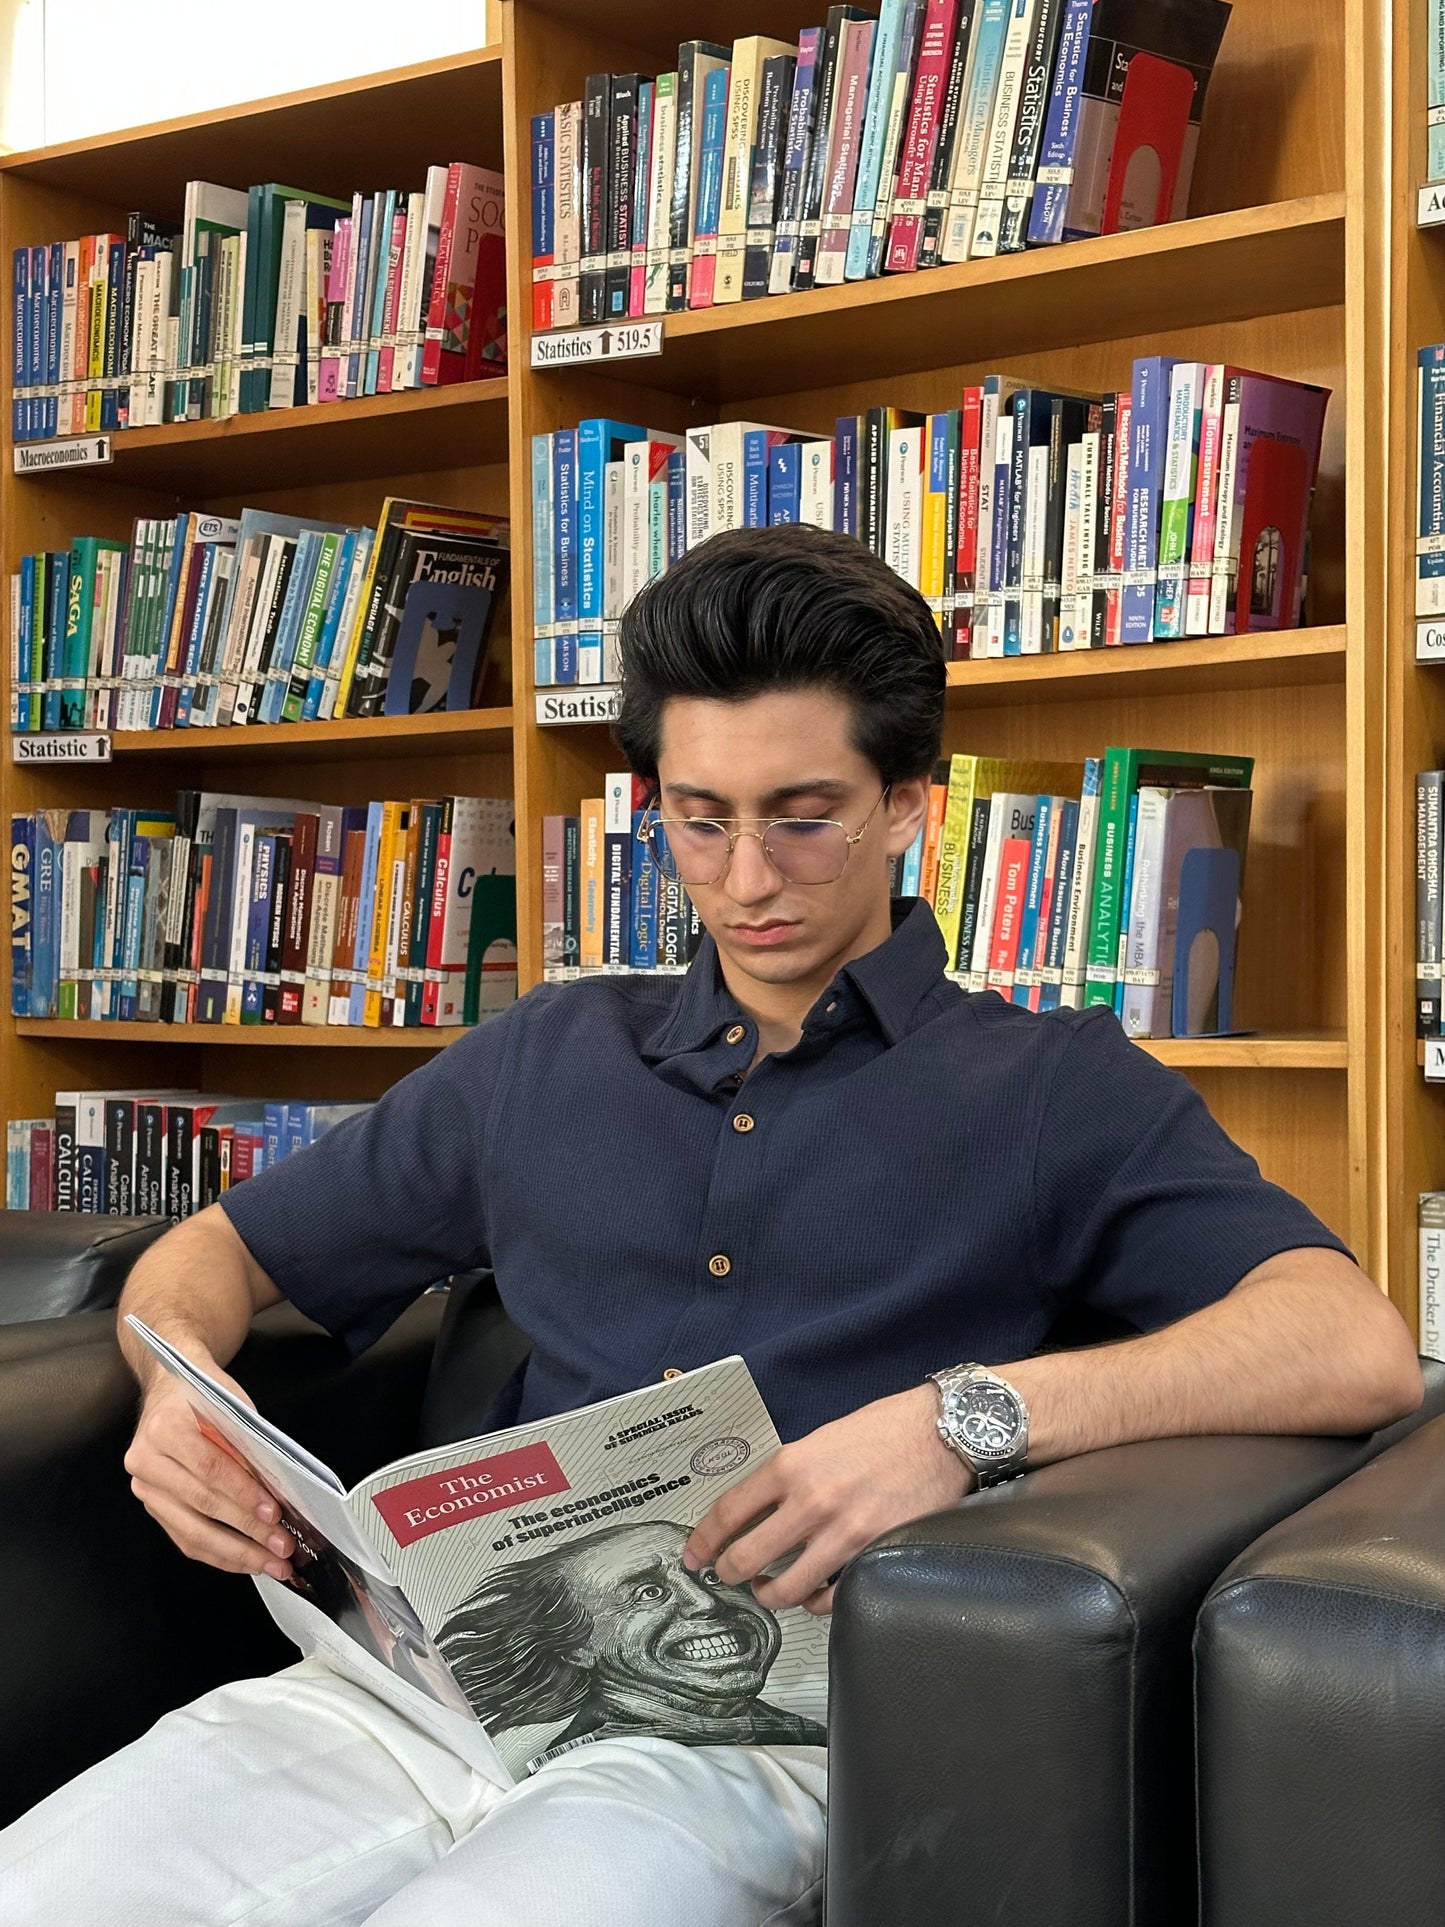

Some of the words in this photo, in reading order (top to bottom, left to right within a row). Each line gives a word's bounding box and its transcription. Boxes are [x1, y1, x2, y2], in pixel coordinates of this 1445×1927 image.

[1071, 12, 1088, 66] Statistics
[980, 46, 996, 98] Statistics
[1055, 32, 1073, 96] Economics
[1069, 69, 1078, 82] for
[733, 80, 741, 113] USING
[793, 90, 801, 112] and
[914, 75, 927, 105] Using
[921, 74, 938, 134] Statistics
[978, 101, 988, 117] for
[997, 72, 1015, 128] BUSINESS
[1018, 66, 1045, 146] Statistics
[1060, 86, 1078, 137] Business
[560, 104, 572, 144] ASIC
[621, 114, 630, 146] Applied
[731, 116, 739, 140] SPSS
[786, 114, 799, 165] Statistics
[794, 88, 809, 151] Probability
[916, 138, 928, 158] for
[966, 121, 986, 175] Managers
[989, 130, 1006, 182] STATISTI
[560, 146, 571, 219] STATISTICS
[620, 149, 628, 202] BUSINESS
[902, 160, 914, 186] Excel
[905, 162, 924, 226] Manars
[468, 197, 505, 229] SOC
[1043, 186, 1054, 223] PEARSON
[1428, 194, 1445, 211] Ac
[619, 204, 627, 250] STATISTI
[76, 281, 87, 375] Macroeconomics
[92, 284, 102, 362] MACROECONOMICS
[384, 280, 394, 334] GOVERNMENT
[16, 294, 25, 374] Macroeconomics
[33, 292, 41, 372] Macroeconomics
[49, 290, 58, 370] Macroeconomics
[537, 334, 592, 360] Statistics
[617, 328, 651, 352] 519.5
[1016, 412, 1024, 442] Pearson
[1120, 409, 1131, 453] Research
[1434, 393, 1445, 456] Financial
[20, 444, 88, 468] Macroeconomics
[960, 449, 968, 490] Business
[968, 449, 977, 472] Basic
[1085, 441, 1093, 465] TURN
[1201, 418, 1217, 517] Biomeasurement
[560, 463, 570, 515] Statistics
[582, 471, 595, 509] Mind
[967, 475, 977, 513] Statistics
[1084, 470, 1092, 498] SMALL
[1118, 454, 1128, 499] Methods
[1431, 460, 1445, 536] Accounting
[203, 522, 218, 533] ETS
[561, 518, 570, 534] for
[583, 515, 592, 533] on
[652, 491, 661, 528] charles
[959, 500, 968, 549] Economics
[967, 517, 976, 530] for
[1012, 505, 1021, 541] Engineers
[1116, 500, 1127, 513] for
[1139, 488, 1148, 542] RESEARCH
[652, 531, 661, 572] wheelan
[1114, 515, 1125, 556] Business
[199, 551, 211, 589] FOREX
[321, 548, 333, 567] THE
[438, 553, 489, 564] FUNDAMENTALS
[490, 558, 500, 566] OF
[561, 537, 570, 586] Business
[583, 537, 596, 609] Statistics
[245, 577, 255, 606] Applied
[272, 555, 287, 608] International
[311, 569, 328, 608] DIGITAL
[67, 575, 83, 638] SAGA
[190, 591, 204, 640] TRADING
[266, 611, 276, 634] Trade
[366, 586, 382, 631] LANGUAGE
[237, 608, 250, 655] International
[298, 612, 318, 665] ECONOMY
[1426, 629, 1445, 648] Cos
[544, 696, 618, 720] Statist
[19, 741, 88, 758] Statistic
[1418, 787, 1426, 800] ON
[324, 821, 334, 852] Rosen
[1036, 806, 1048, 846] Business
[1428, 786, 1438, 847] SUMANTRA
[1418, 802, 1426, 880] MANAGEMENT
[40, 848, 53, 892] GRE
[259, 845, 271, 900] PHYSICS
[612, 844, 622, 882] DIGITAL
[937, 842, 955, 915] BUSINESS
[1006, 862, 1020, 890] Tom
[1028, 848, 1044, 909] Environment
[1060, 850, 1070, 879] Moral
[1074, 843, 1086, 886] Business
[1428, 849, 1437, 901] GHOSHAL
[11, 844, 31, 950] GMAT
[298, 869, 306, 901] Discrete
[376, 878, 385, 910] LINEAR
[640, 862, 652, 908] Digital
[1056, 881, 1067, 913] Issues
[1135, 859, 1150, 918] Rethinking
[294, 902, 304, 950] Mathematics
[310, 905, 322, 965] Applications
[373, 912, 382, 952] ALGEBRA
[610, 887, 621, 964] FUNDAMENTALS
[638, 914, 651, 951] Logic
[1000, 894, 1017, 940] Peters
[1055, 915, 1064, 925] in
[1067, 889, 1082, 952] Environment
[998, 950, 1008, 968] Re-
[1050, 927, 1062, 966] Busines
[1134, 942, 1144, 968] MBA
[109, 1158, 119, 1202] Analytic
[139, 1164, 150, 1211] Analytic
[169, 1166, 180, 1212] Analytic
[1427, 1234, 1440, 1263] The
[1426, 1267, 1440, 1326] Drucker
[617, 1417, 661, 1439] SPECIAL
[662, 1404, 694, 1420] ISSUE
[620, 1422, 667, 1445] SUMMER
[668, 1408, 704, 1426] READS
[402, 1470, 549, 1528] Economist
[439, 1470, 494, 1496] The
[509, 1512, 548, 1530] The
[550, 1472, 661, 1520] economics
[492, 1534, 516, 1552] of
[516, 1474, 692, 1546] superintelligence
